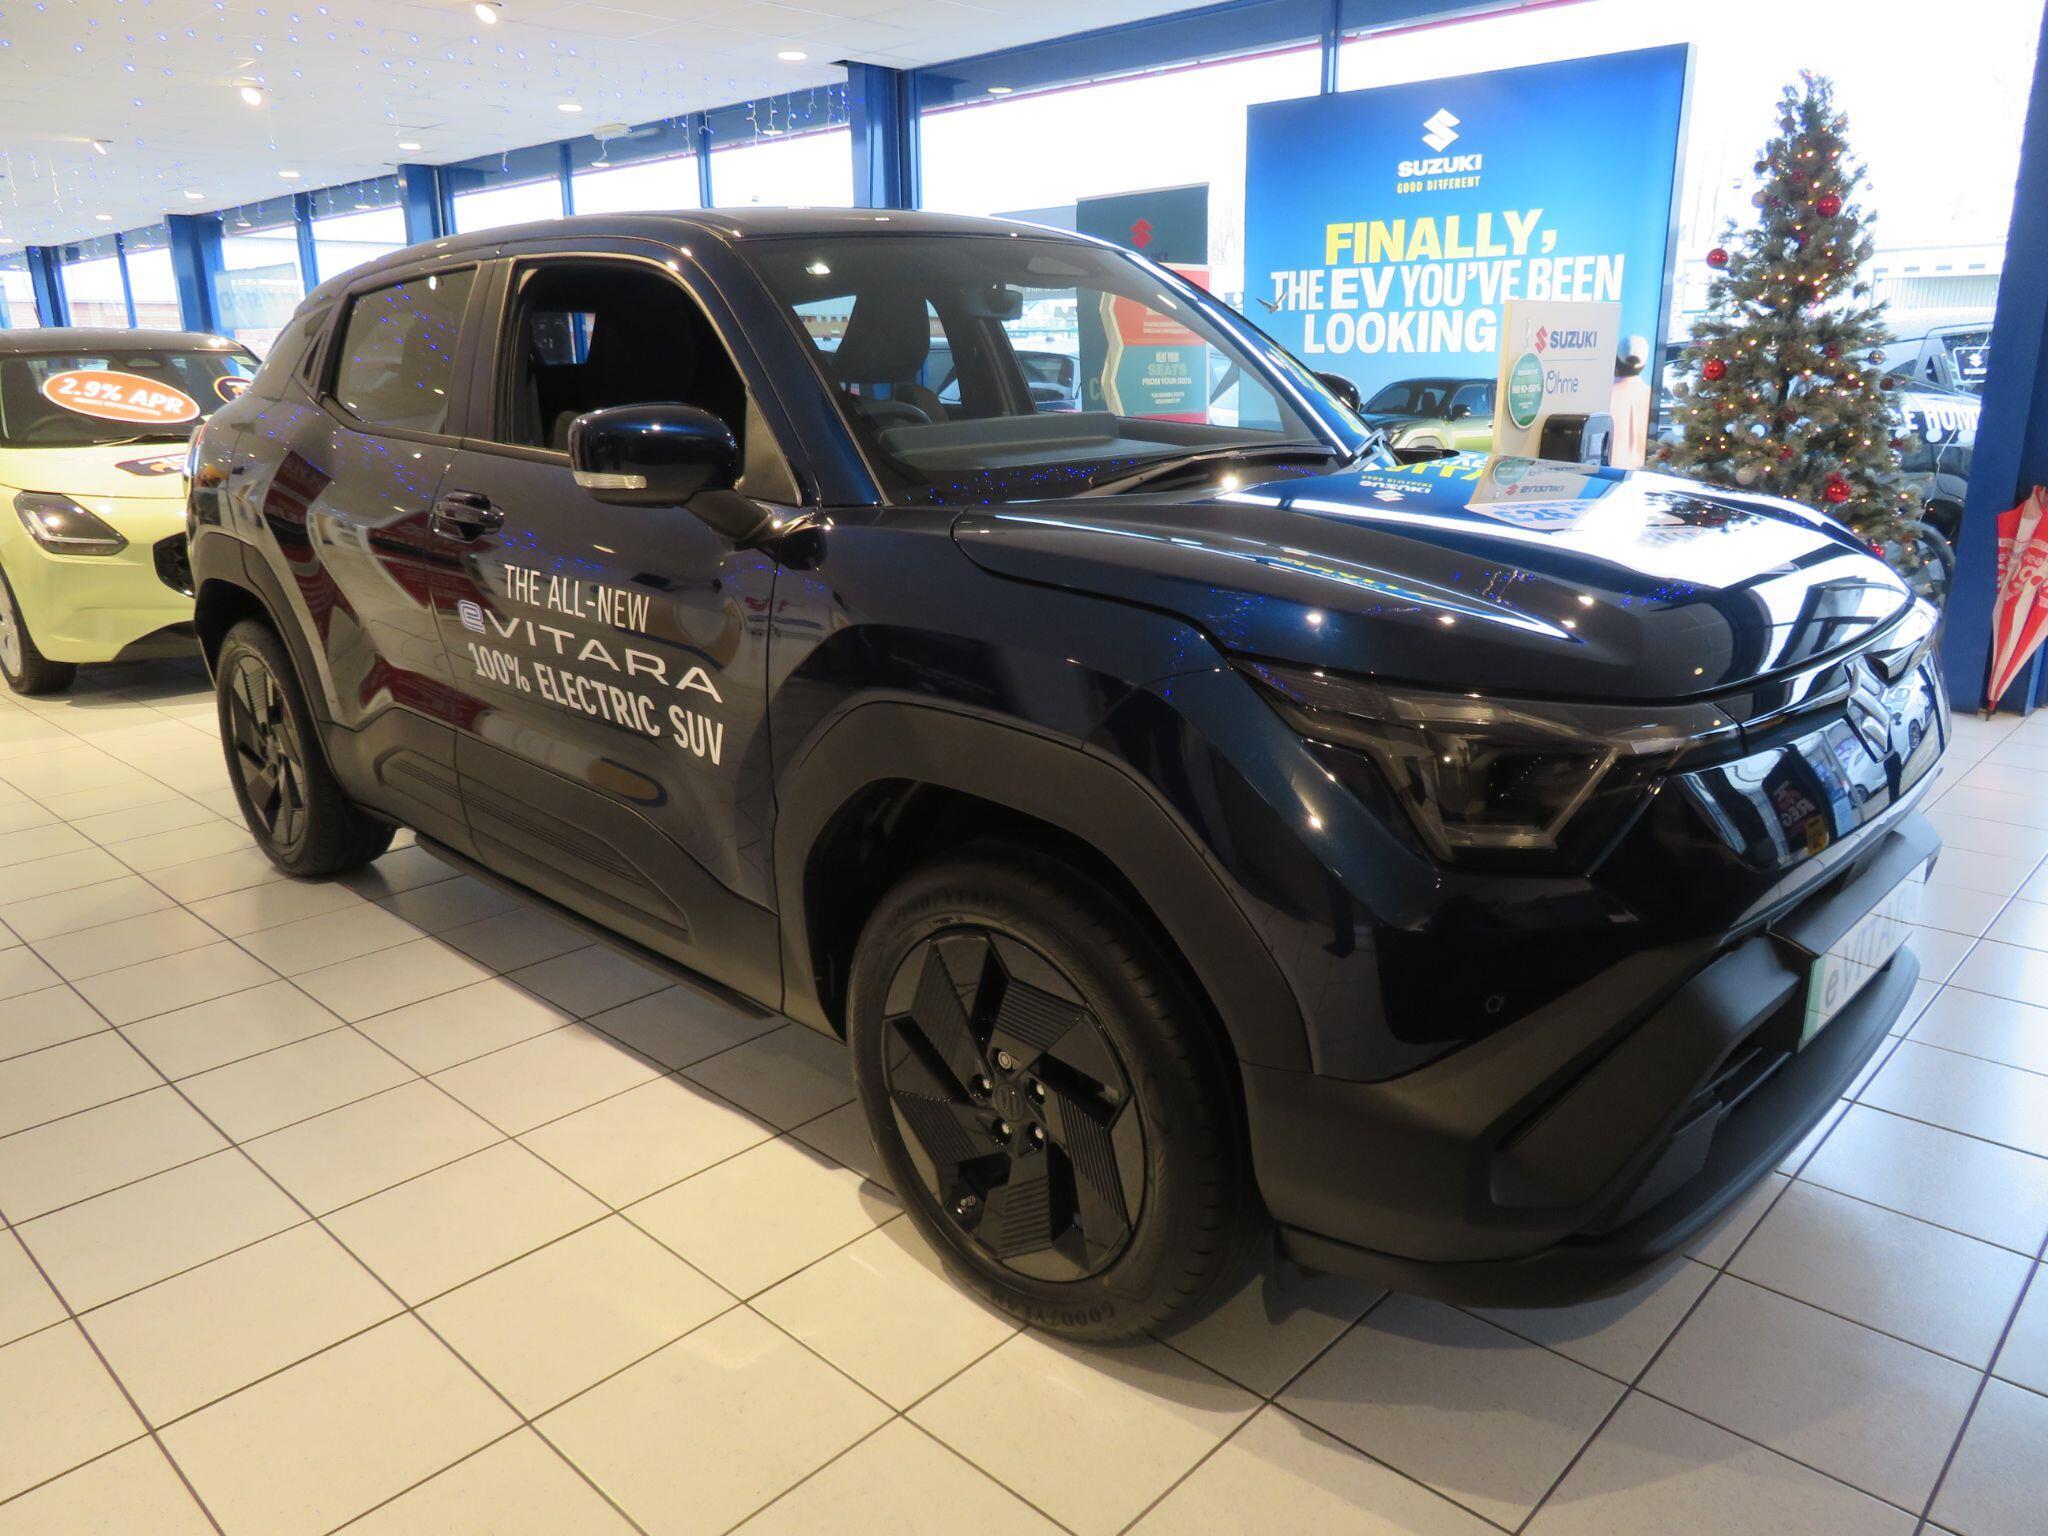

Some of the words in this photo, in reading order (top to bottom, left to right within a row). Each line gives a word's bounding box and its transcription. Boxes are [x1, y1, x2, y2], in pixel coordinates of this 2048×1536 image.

[1396, 181, 1423, 194] GOOD
[1427, 176, 1481, 192] DIFFERENT
[1397, 153, 1483, 178] SUZUKI
[1325, 208, 1558, 266] FINALLY,
[1270, 269, 1325, 312] THE
[1330, 265, 1396, 309] EV
[1402, 258, 1523, 308] YOU'VE
[1527, 254, 1626, 302] BEEN
[1304, 309, 1498, 354] LOOKING
[1550, 330, 1598, 350] SUZUKI
[57, 378, 123, 402] 2.9%
[127, 389, 185, 415] APR
[1545, 369, 1580, 395] Ohme
[504, 563, 541, 607] THE
[547, 575, 650, 633] ALL-NEW
[468, 642, 531, 693] 100%
[533, 661, 661, 737] ELECTRIC
[668, 704, 724, 766] SUV
